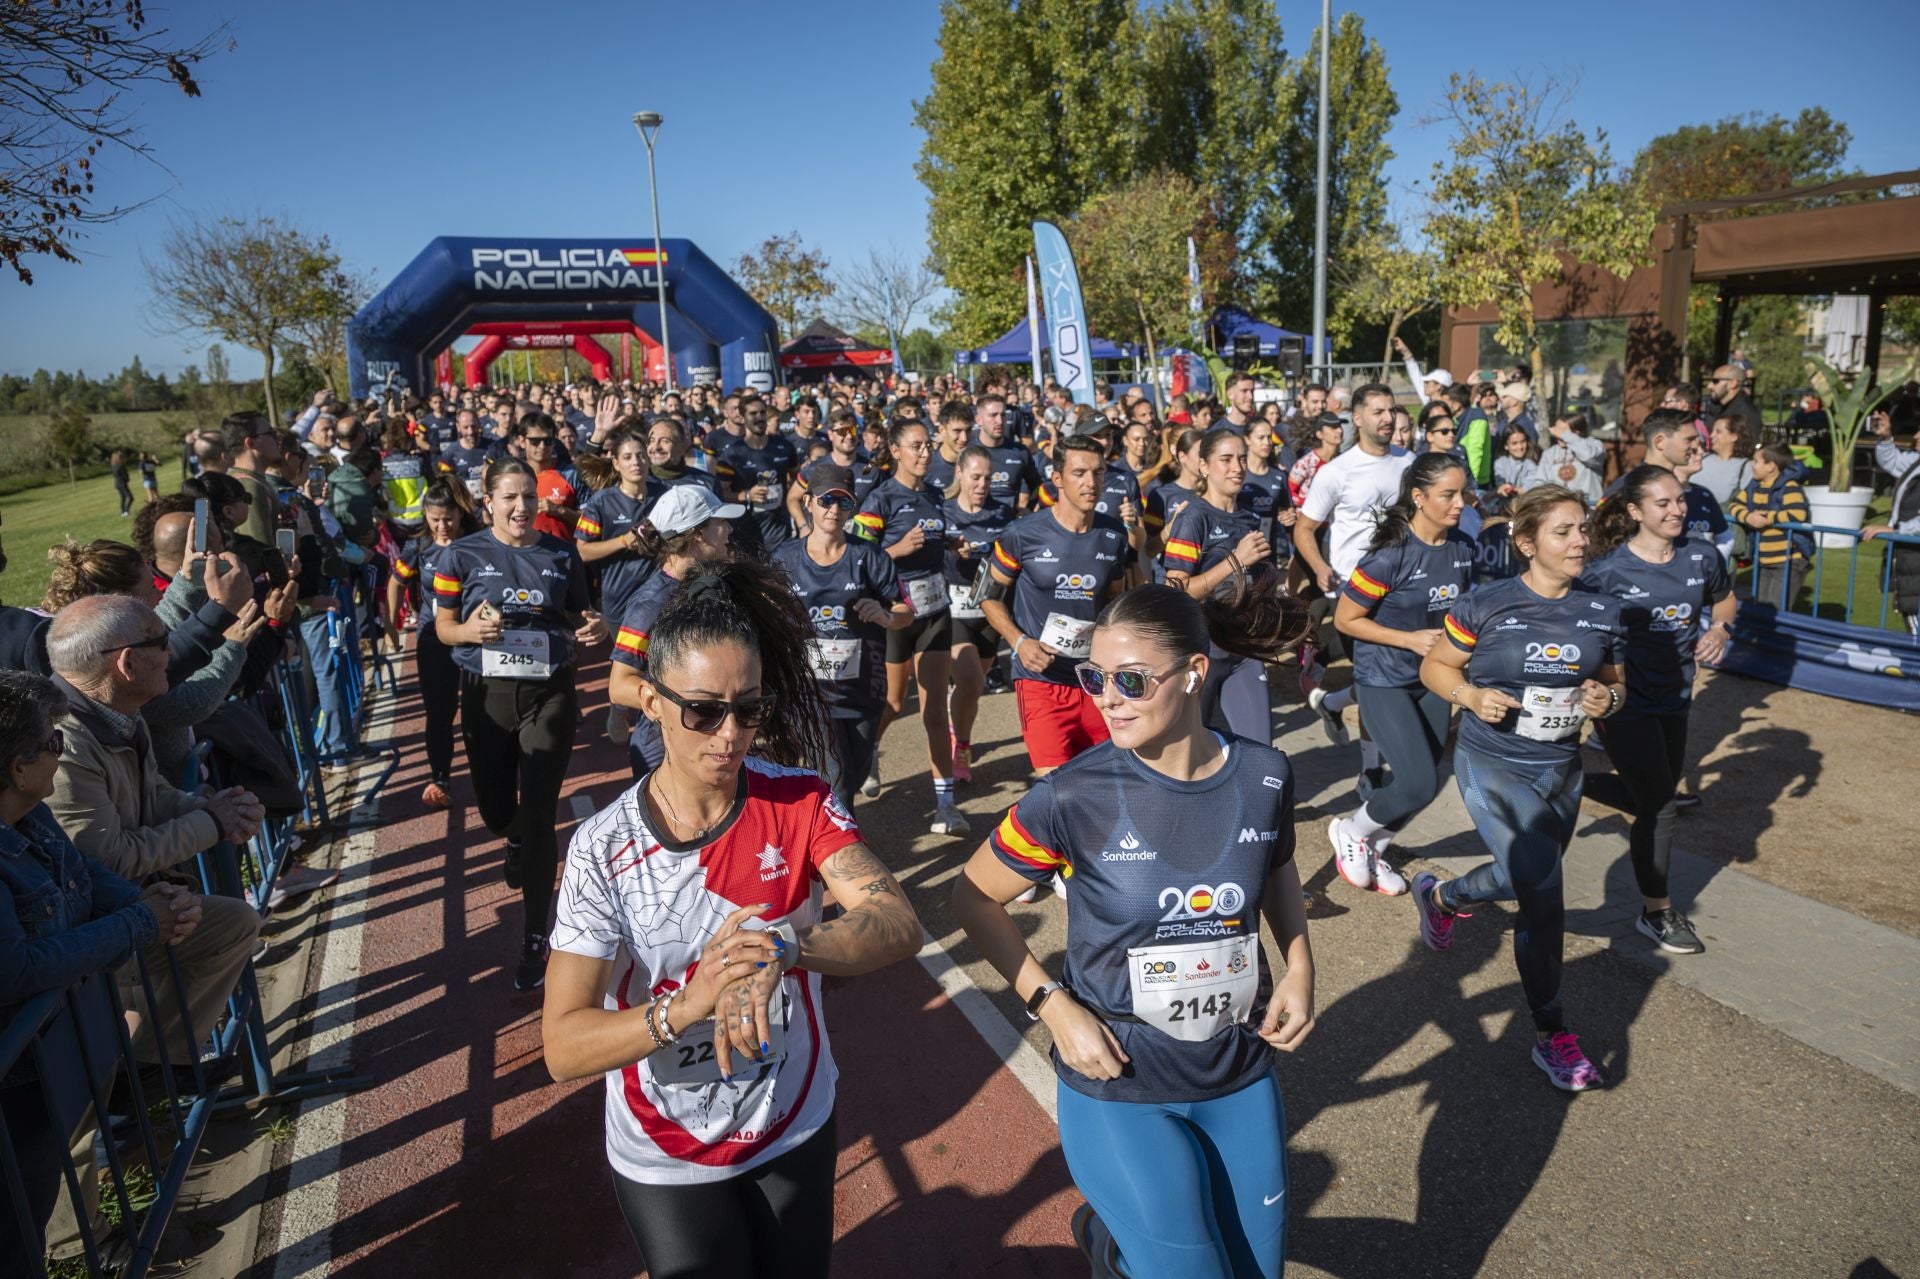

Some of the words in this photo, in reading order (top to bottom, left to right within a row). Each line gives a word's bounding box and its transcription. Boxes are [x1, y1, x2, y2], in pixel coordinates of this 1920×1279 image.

[472, 249, 630, 267] POLICIA
[474, 269, 669, 289] NACIONAL
[743, 352, 772, 371] RUTA
[1056, 574, 1096, 589] 200
[502, 587, 544, 606] 200
[1429, 583, 1459, 602] 200
[809, 605, 846, 622] 200
[1651, 602, 1692, 622] 200
[500, 654, 534, 665] 2445
[1525, 642, 1581, 662] 200
[1524, 667, 1578, 675] NACIONAL
[1540, 715, 1579, 729] 2332
[1102, 851, 1157, 862] Santander
[760, 866, 790, 882] luanvi
[1158, 882, 1245, 922] 200
[1155, 928, 1237, 940] NACIONAL
[1157, 920, 1223, 933] POLICIA
[1143, 961, 1176, 975] 200
[1185, 970, 1221, 981] Santander
[1168, 992, 1232, 1022] 2143
[678, 1041, 715, 1069] 22
